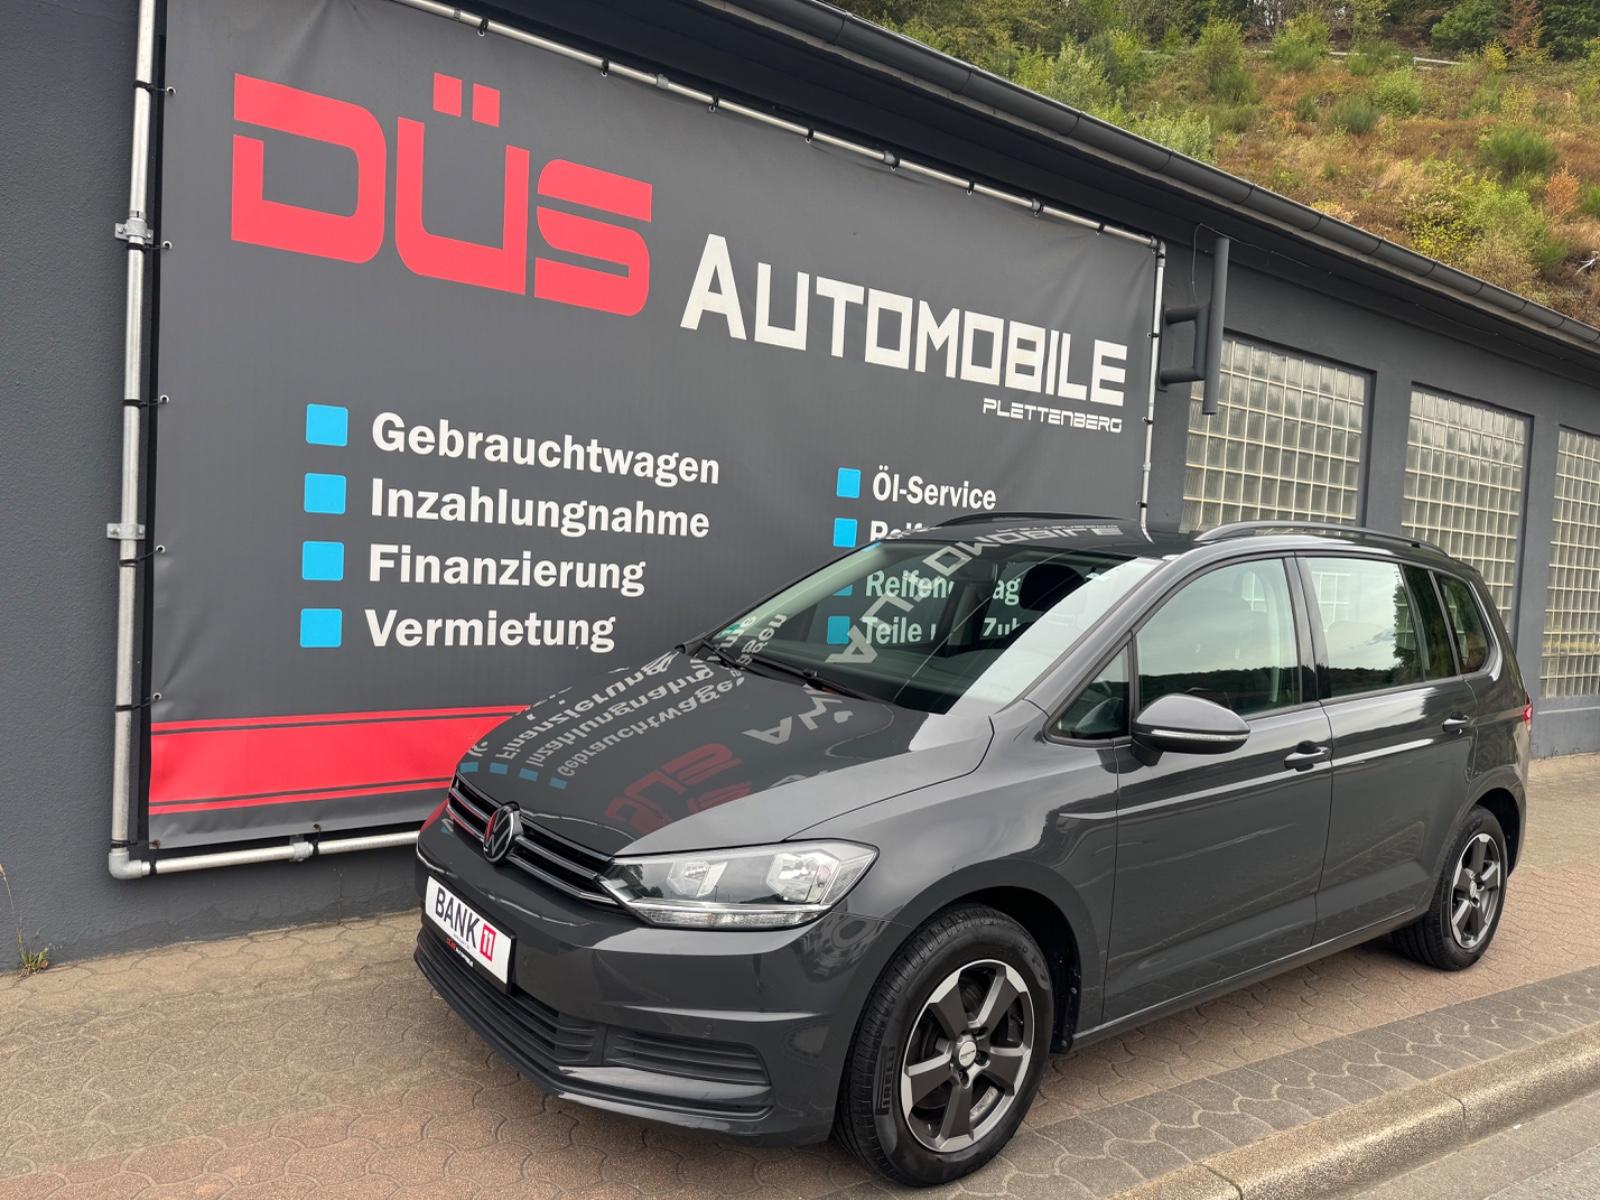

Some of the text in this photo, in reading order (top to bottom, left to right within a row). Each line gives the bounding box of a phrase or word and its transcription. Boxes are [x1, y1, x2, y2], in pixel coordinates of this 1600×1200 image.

[231, 72, 1128, 406] DÜS AUTOMOBILE
[982, 397, 1123, 433] PLETTENBERG
[371, 411, 720, 487] Gebrauchtwagen
[371, 478, 710, 538] Inzahlungnahme
[872, 465, 997, 511] Öl-Service
[369, 543, 646, 598] Finanzierung
[364, 608, 616, 653] Vermietung
[862, 616, 922, 645] Teile
[435, 886, 480, 950] BANK
